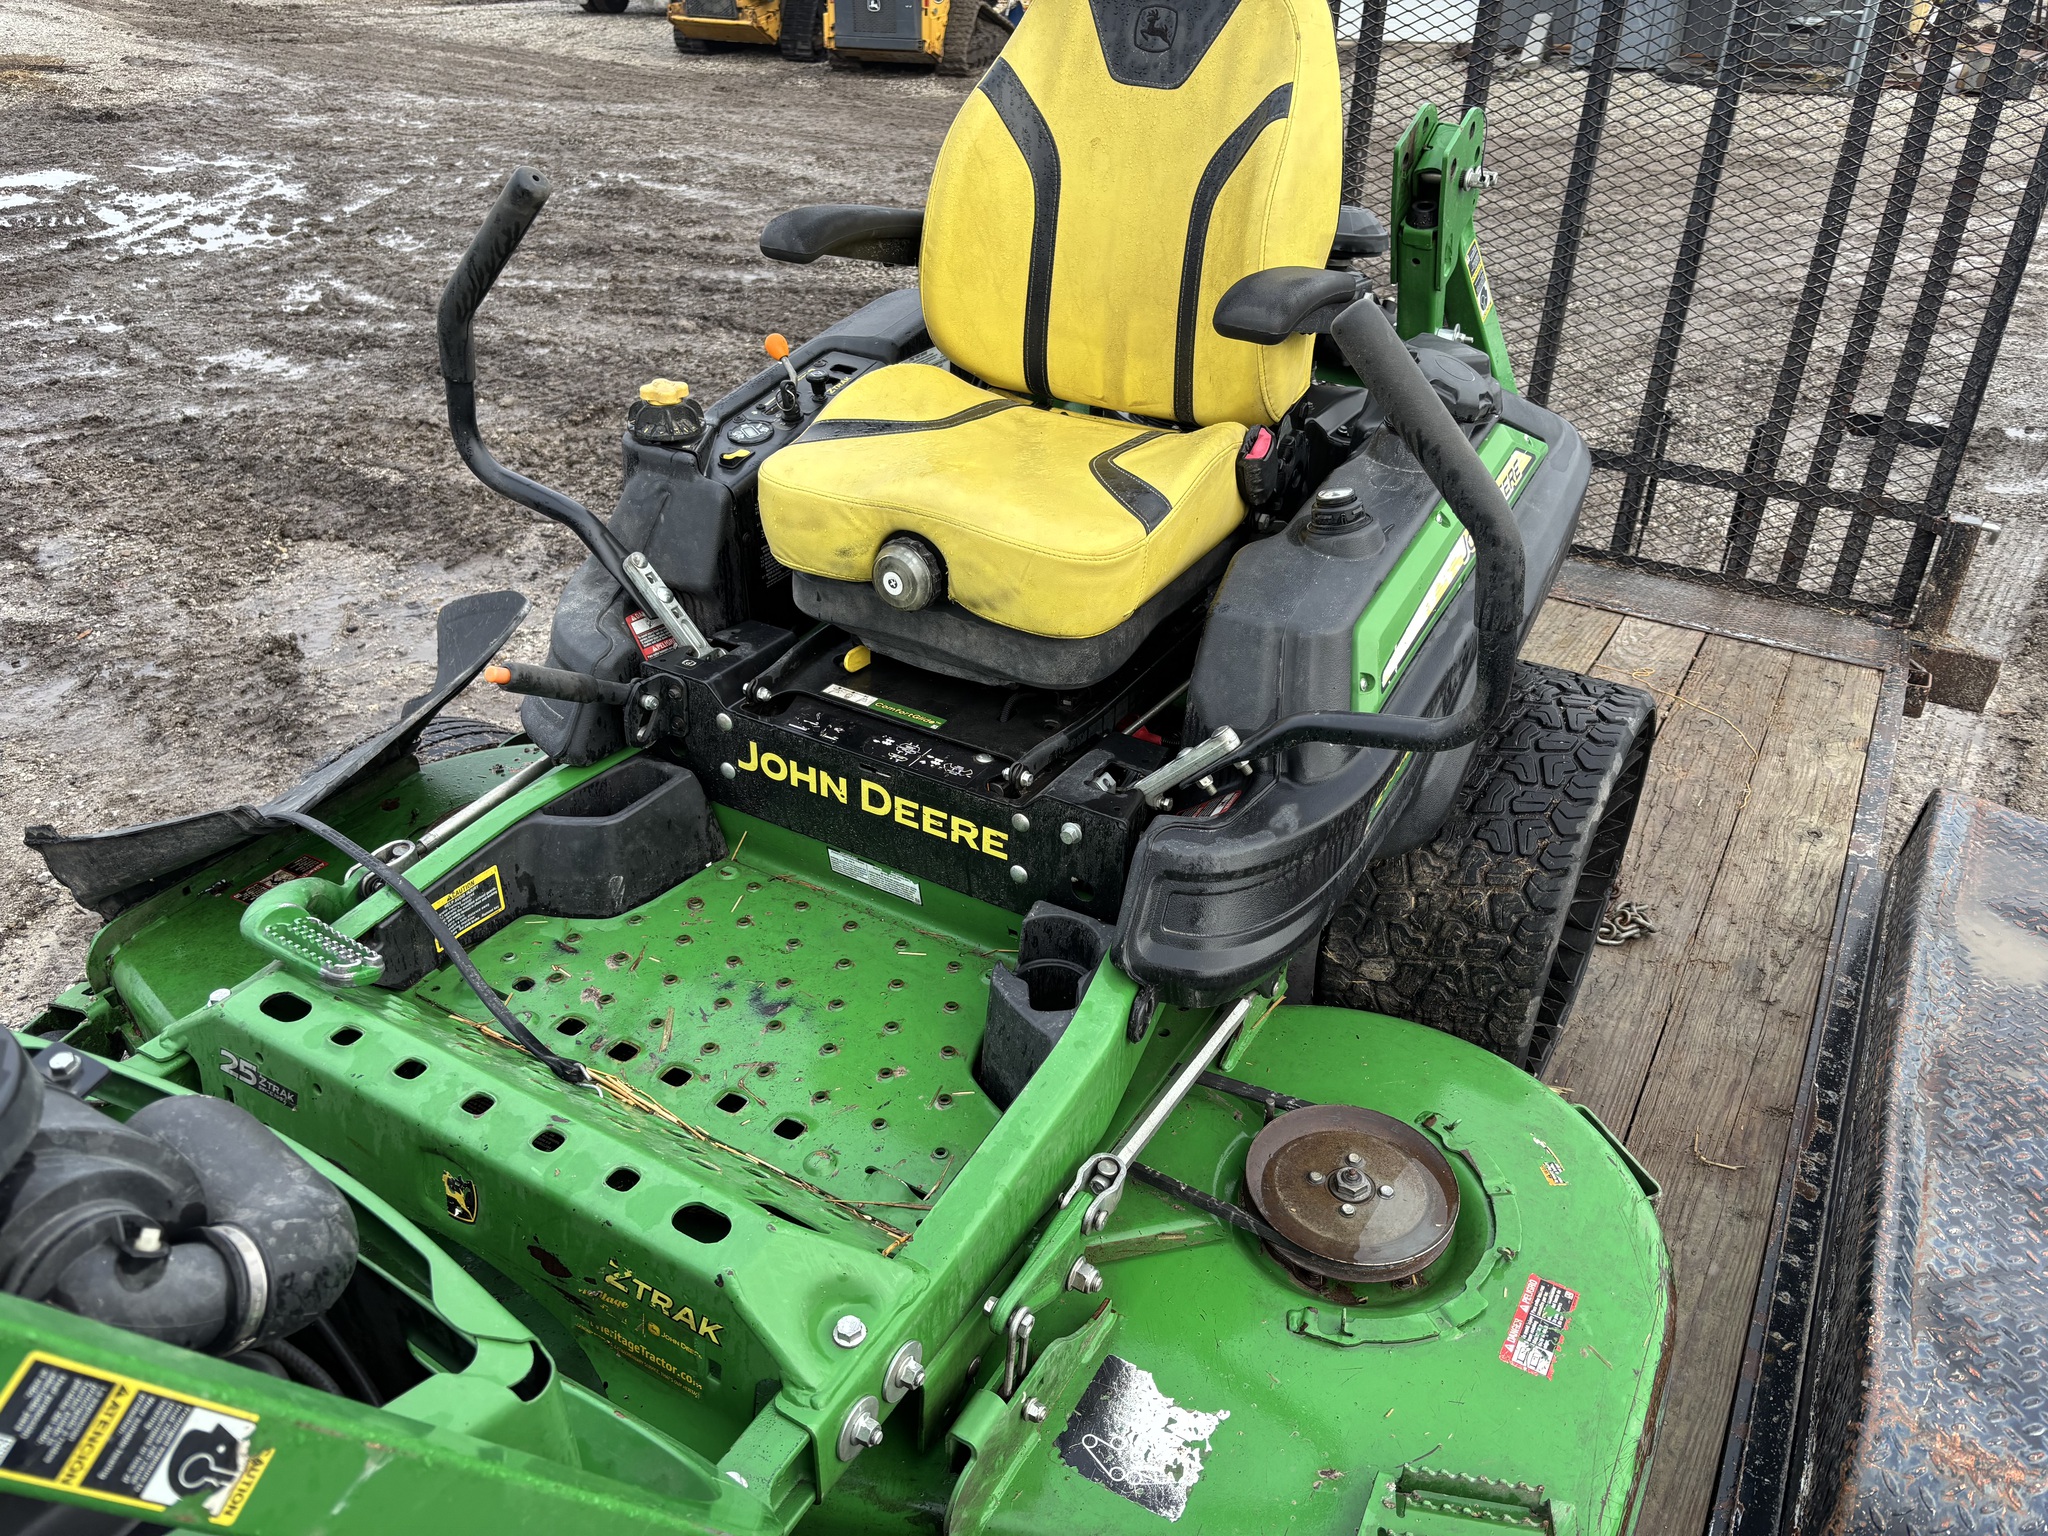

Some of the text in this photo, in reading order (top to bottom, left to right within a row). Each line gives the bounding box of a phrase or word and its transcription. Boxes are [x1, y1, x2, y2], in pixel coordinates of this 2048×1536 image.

[826, 376, 852, 395] ZTRAK
[737, 740, 1010, 861] JOHN DEERE
[452, 880, 475, 897] CAUTION
[220, 1049, 257, 1086] 25
[258, 1075, 295, 1103] ZTRAK
[604, 1258, 723, 1347] ZTRAK
[1523, 1279, 1538, 1304] PELIGRO
[1506, 1318, 1524, 1343] DANGER
[661, 1332, 703, 1360] JOHN DEE
